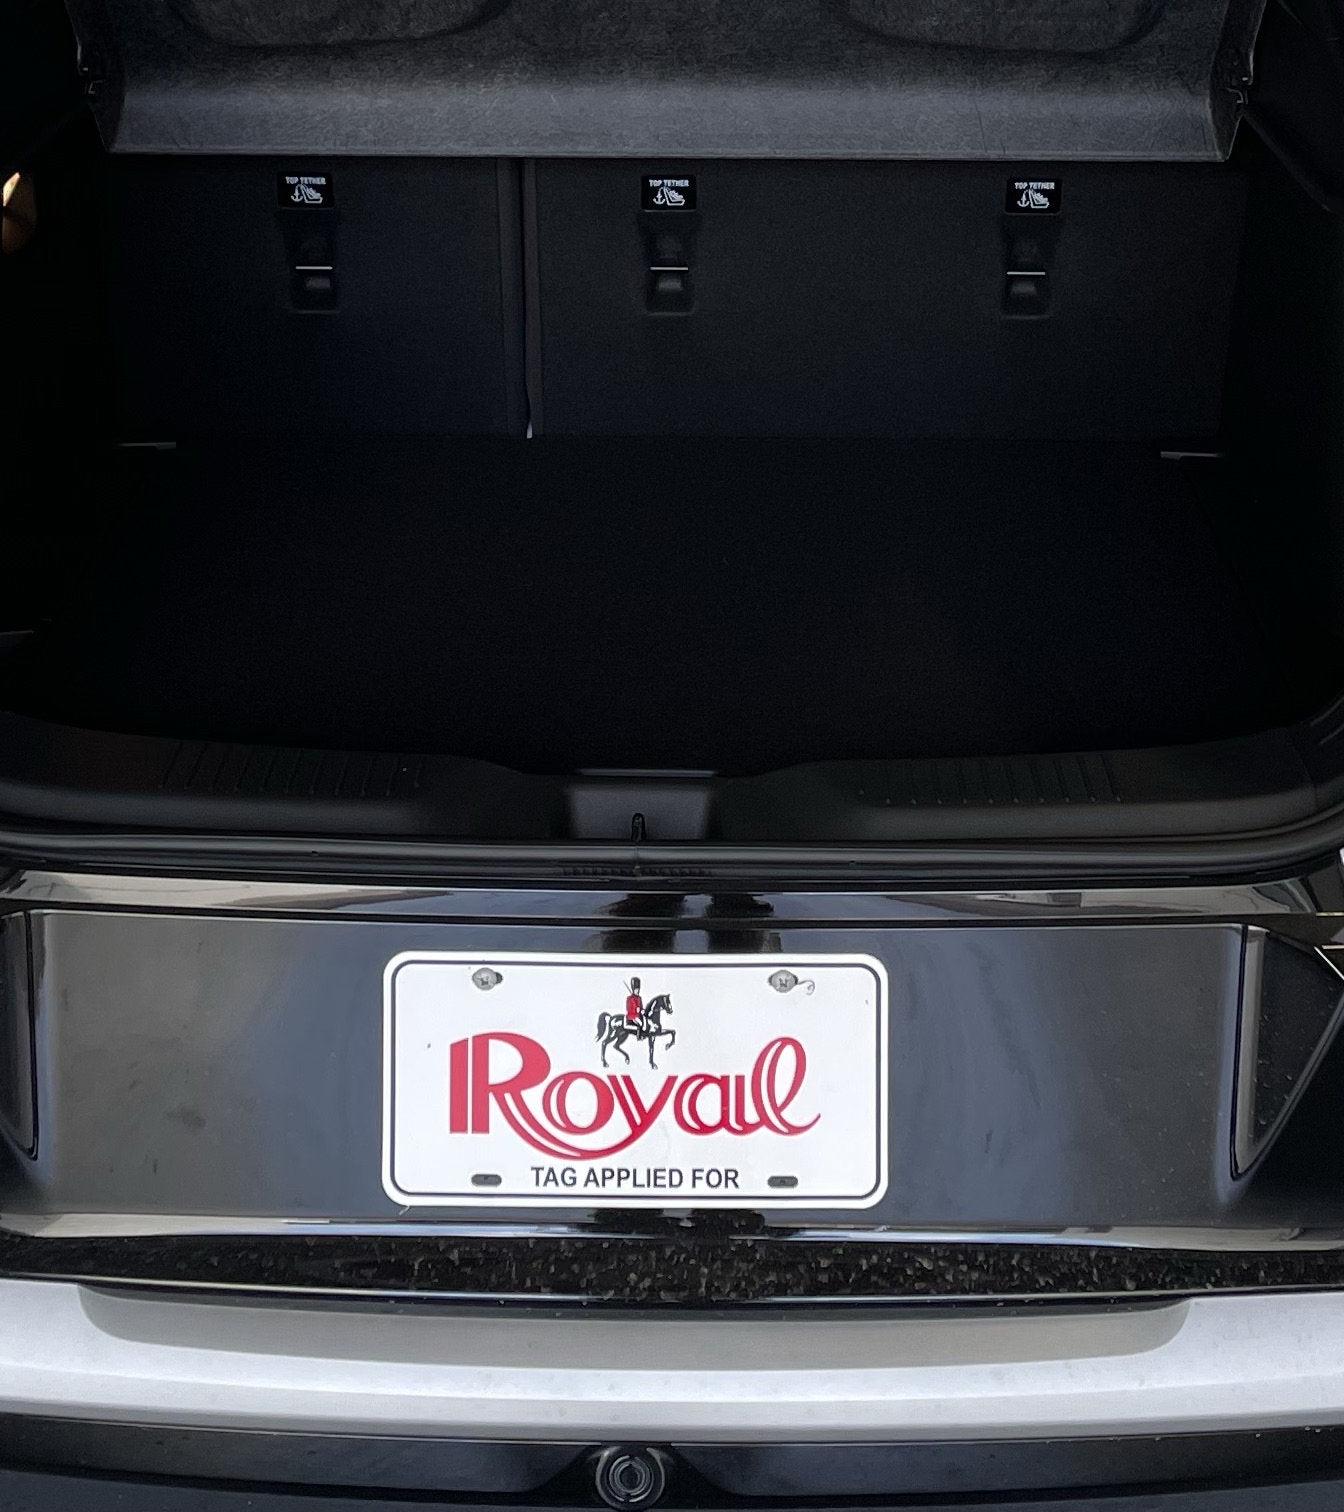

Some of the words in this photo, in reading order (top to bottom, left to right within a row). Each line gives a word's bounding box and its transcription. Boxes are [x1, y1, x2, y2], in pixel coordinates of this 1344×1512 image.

[285, 176, 299, 185] TOP
[299, 176, 327, 185] TETHER
[648, 179, 663, 187] TOP
[663, 179, 690, 187] TETHER
[1014, 182, 1028, 190] TOP
[1028, 182, 1055, 190] TETHER
[449, 1031, 822, 1160] Royal
[530, 1166, 578, 1188] TAG
[583, 1167, 684, 1188] APPLIED
[691, 1168, 740, 1189] FOR
